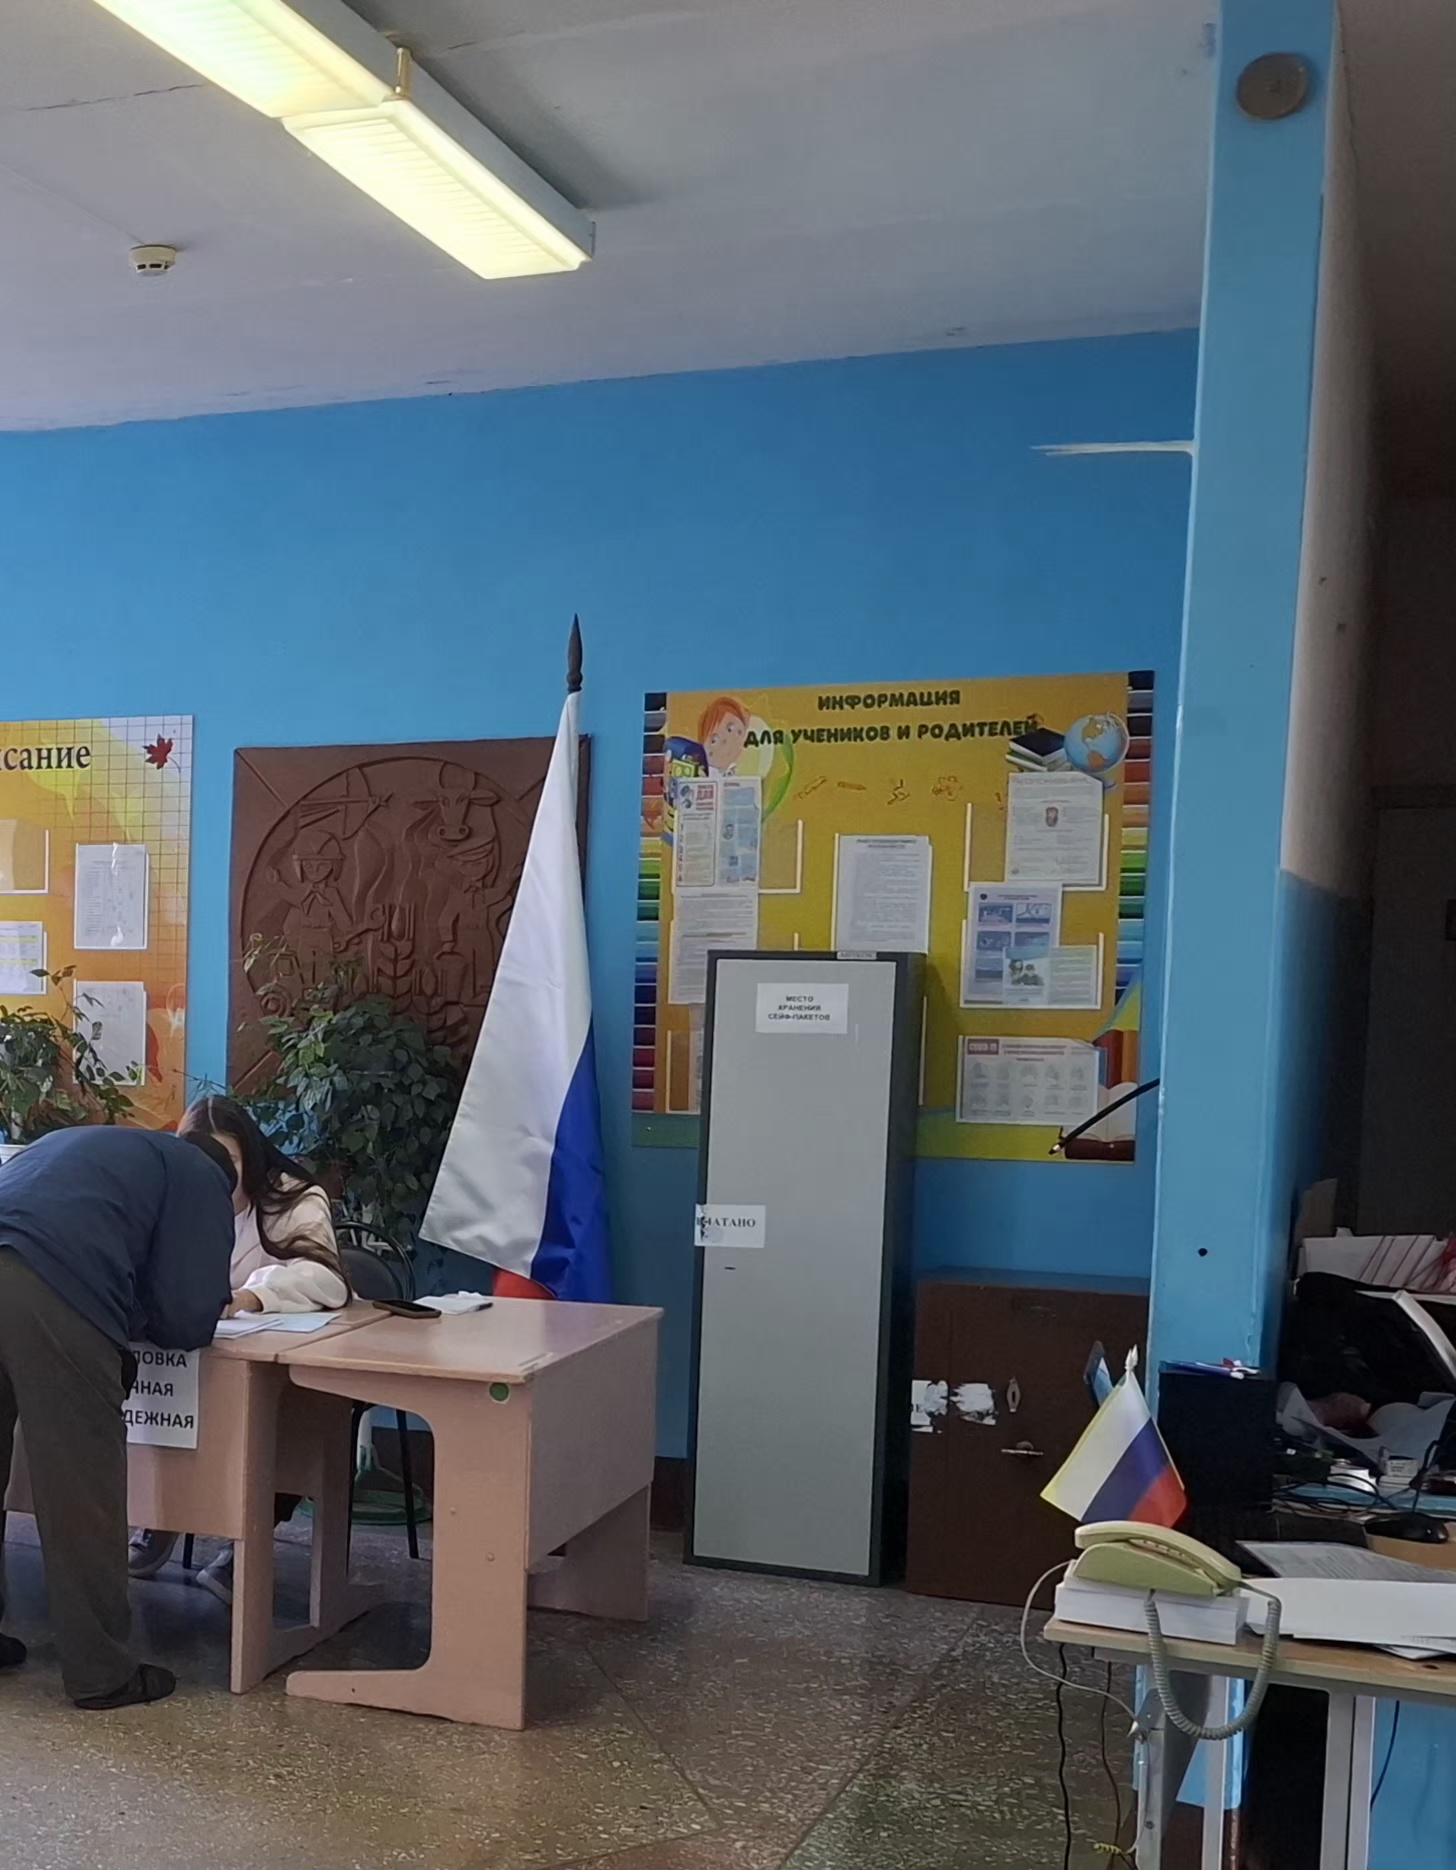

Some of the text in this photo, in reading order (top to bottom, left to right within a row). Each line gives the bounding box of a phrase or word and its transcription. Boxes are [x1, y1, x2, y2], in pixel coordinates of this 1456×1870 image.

[817, 689, 961, 711] ИНФОРМАЦИЯ
[744, 729, 784, 748] ДЛЯ
[790, 725, 891, 745] УЧЕНИКОВ
[897, 725, 911, 740] И
[785, 995, 814, 1003] МЕСТО
[777, 1004, 821, 1012] ХРАНЕНИЯ
[767, 1013, 831, 1021] СЕЙФ-ПАКЕТОВ
